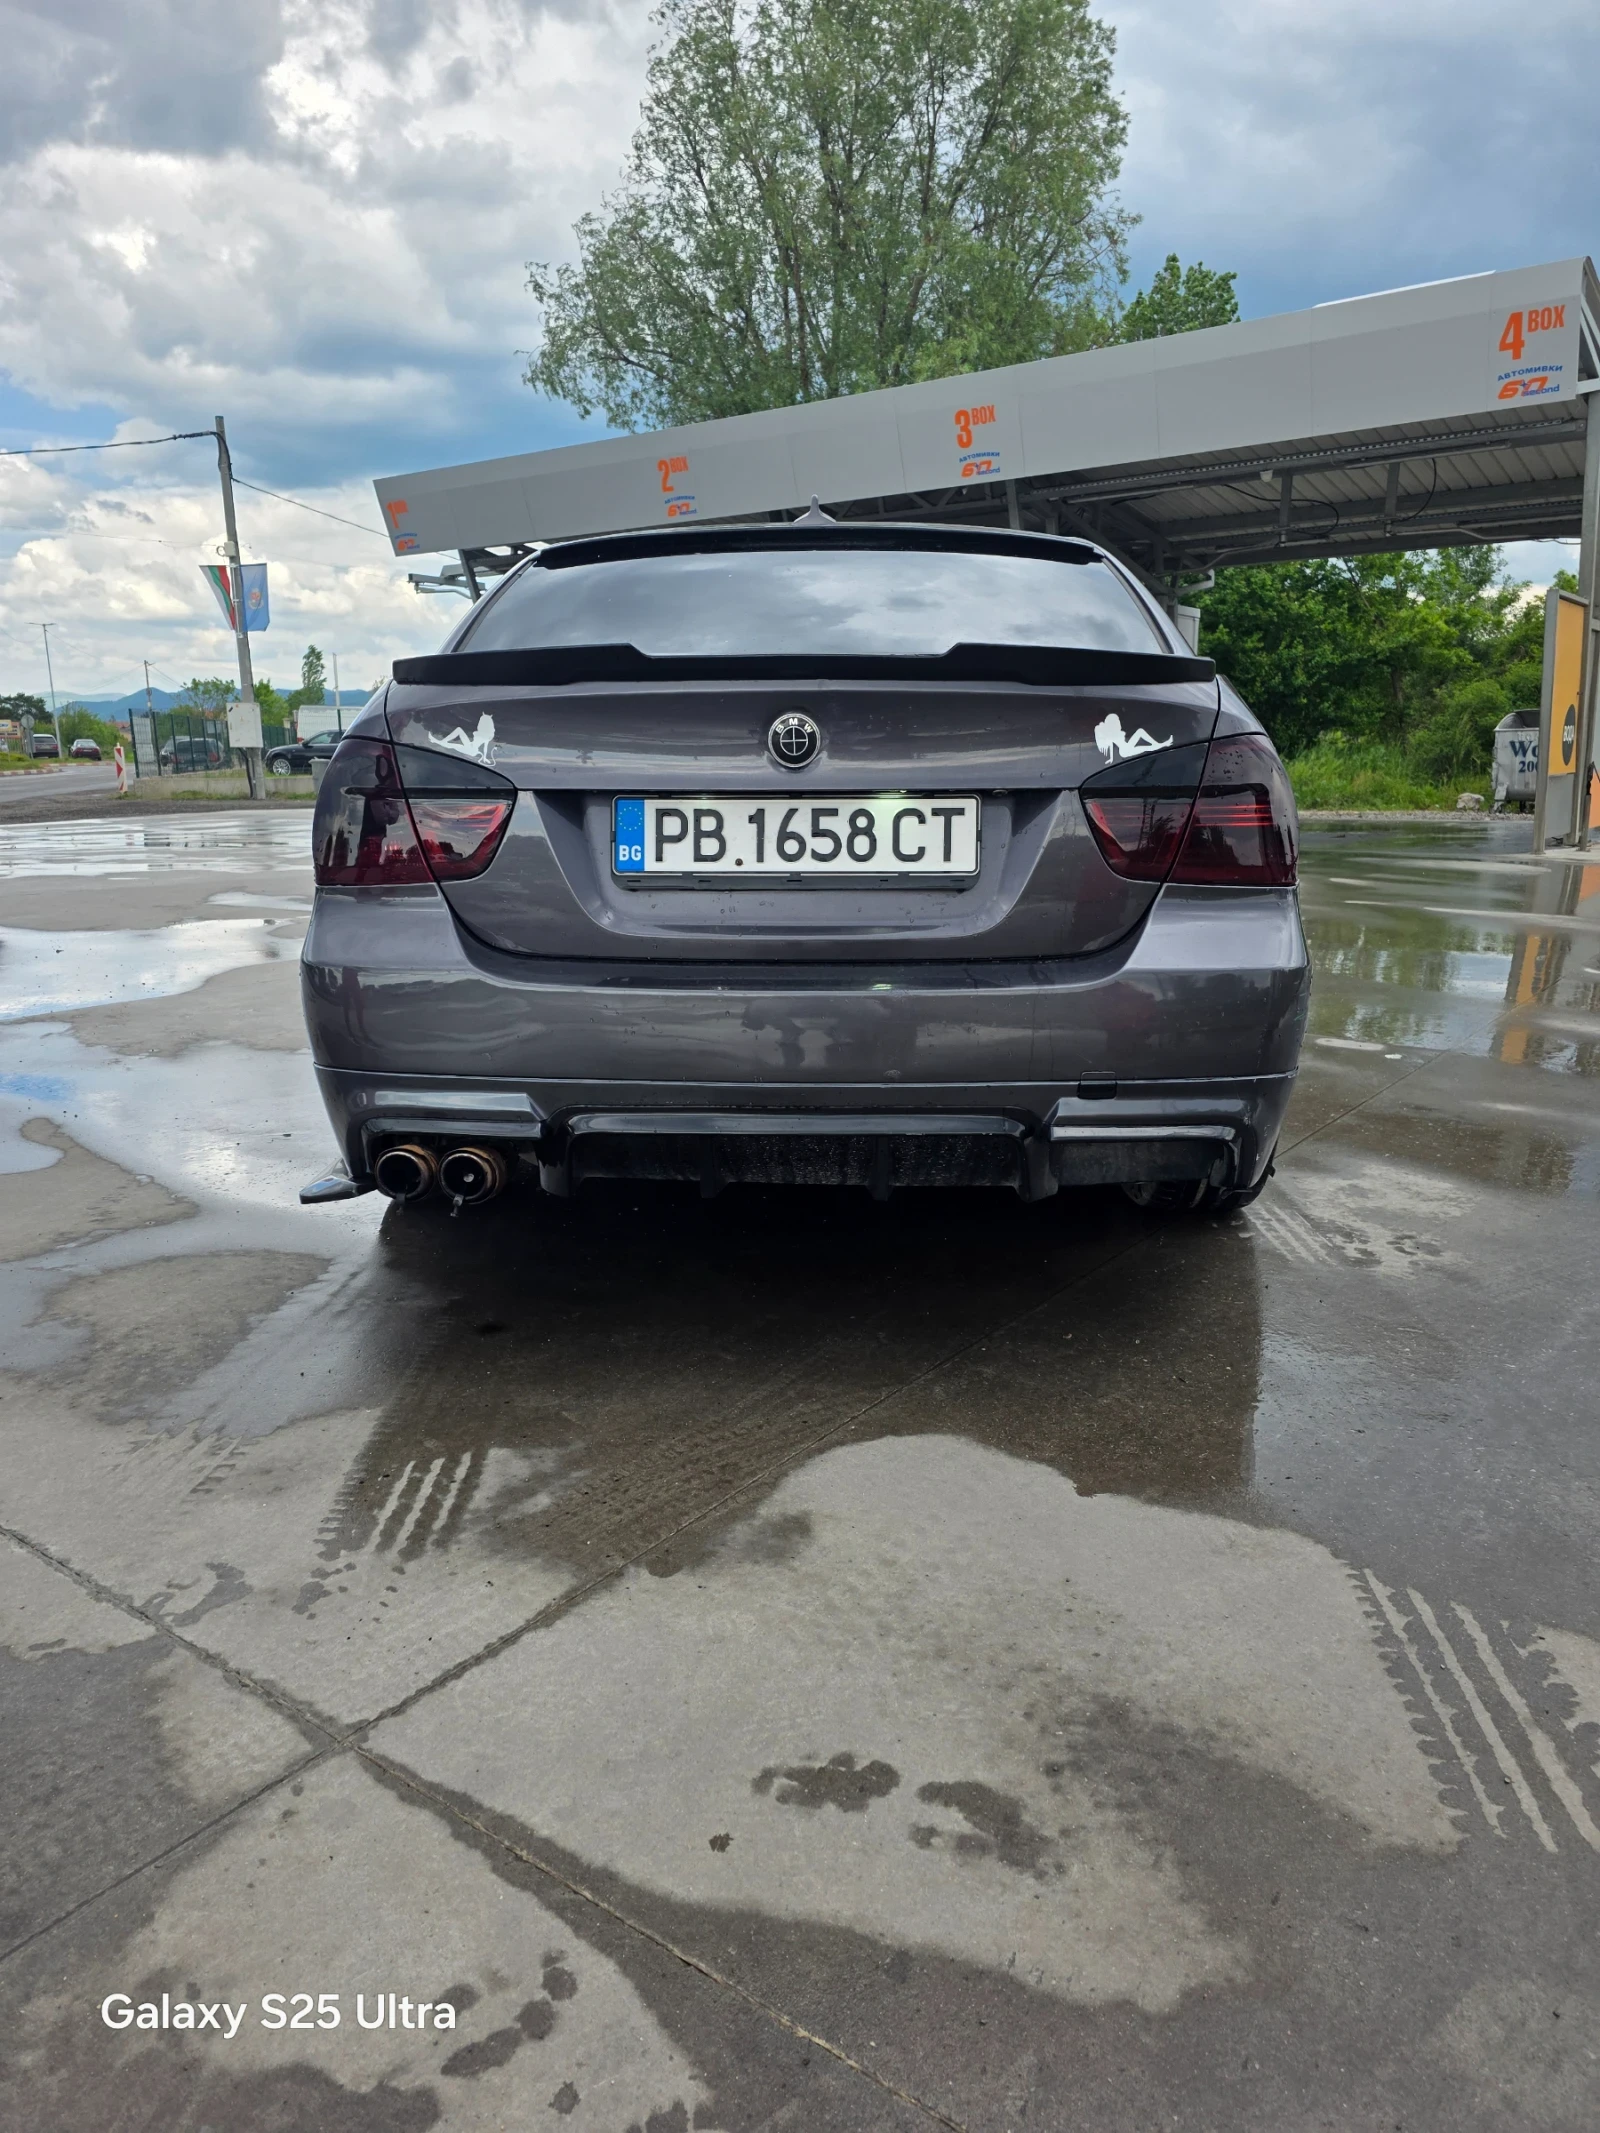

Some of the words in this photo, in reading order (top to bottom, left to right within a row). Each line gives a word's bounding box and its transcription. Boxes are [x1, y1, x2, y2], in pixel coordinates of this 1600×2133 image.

[1498, 311, 1525, 361] 4
[1527, 304, 1566, 333] BOX
[1497, 364, 1563, 382] АВТОМИВКИ
[1522, 384, 1560, 397] second
[954, 409, 973, 449] 3
[971, 404, 996, 426] BOX
[657, 459, 674, 493] 2
[775, 717, 813, 734] BMW
[655, 808, 727, 863] PB
[748, 808, 878, 863] 1658
[892, 808, 966, 863] CT
[618, 845, 643, 862] BG
